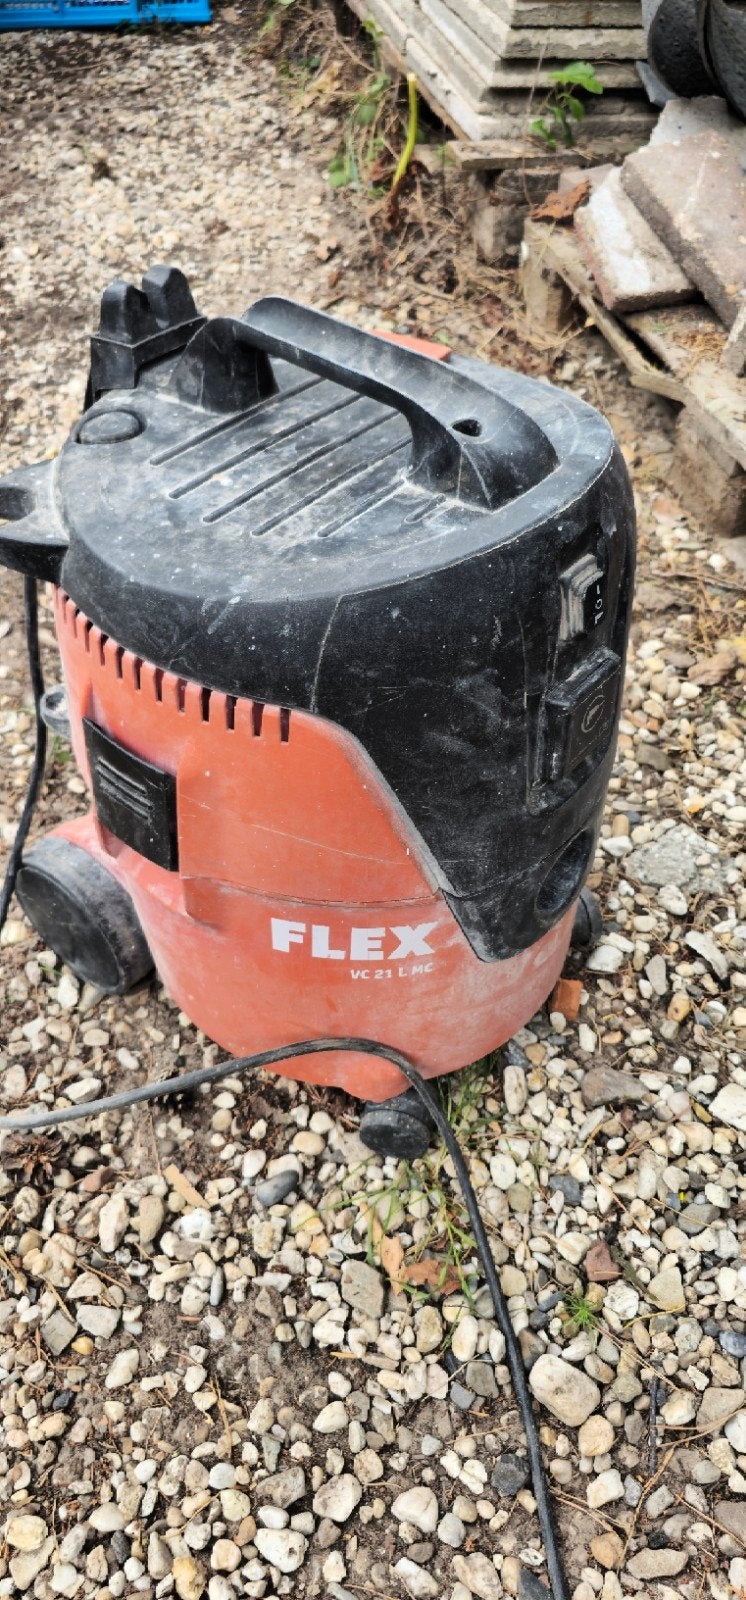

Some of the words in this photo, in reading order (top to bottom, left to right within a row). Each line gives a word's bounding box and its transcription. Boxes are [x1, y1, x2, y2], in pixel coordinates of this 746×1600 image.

[270, 917, 439, 961] FLEX
[350, 968, 370, 980] VC
[374, 968, 393, 980] 21
[398, 966, 408, 978] L
[411, 962, 433, 976] MC
